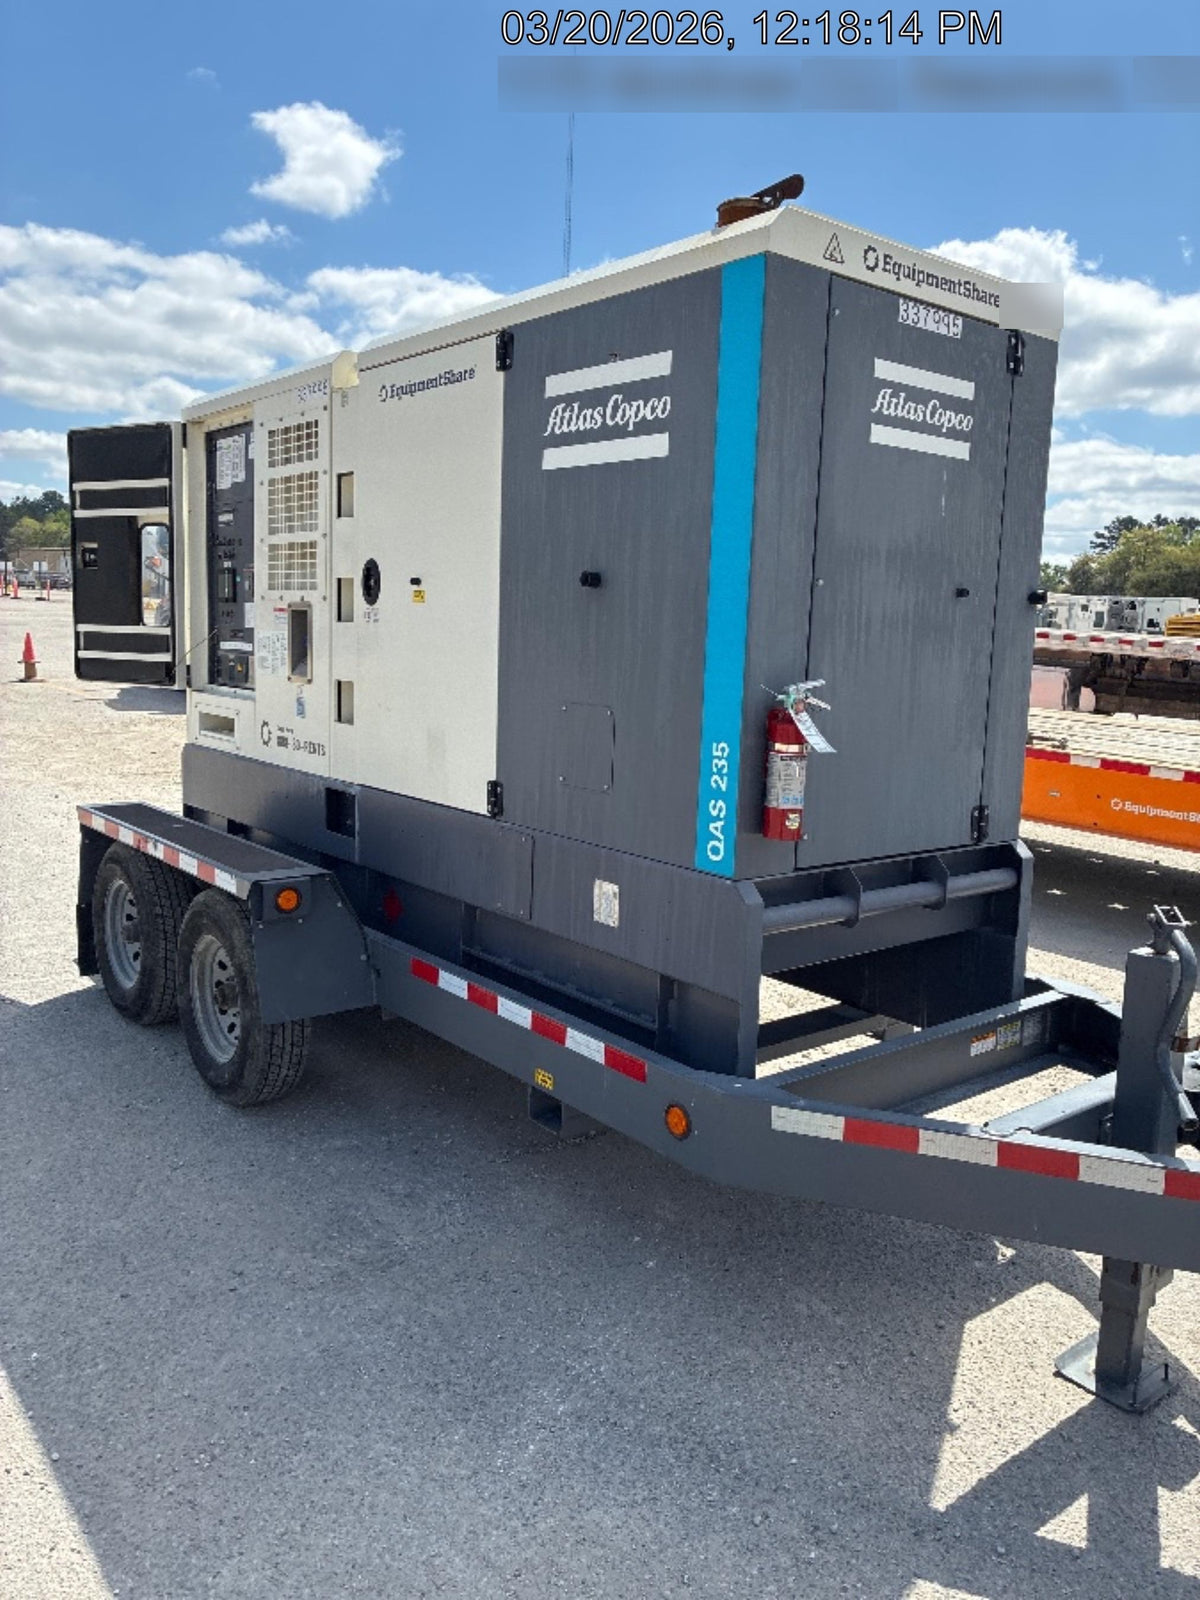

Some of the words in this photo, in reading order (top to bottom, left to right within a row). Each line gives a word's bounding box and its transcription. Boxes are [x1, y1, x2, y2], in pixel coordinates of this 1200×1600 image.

[881, 254, 1000, 308] EquipmentShare
[901, 300, 960, 336] 337995
[389, 367, 476, 400] EquipmentShare
[543, 401, 604, 436] Atlas
[606, 394, 671, 431] Copco
[871, 388, 924, 422] Atlas
[926, 399, 974, 432] Copco
[711, 742, 730, 792] 235
[707, 800, 727, 861] QAS
